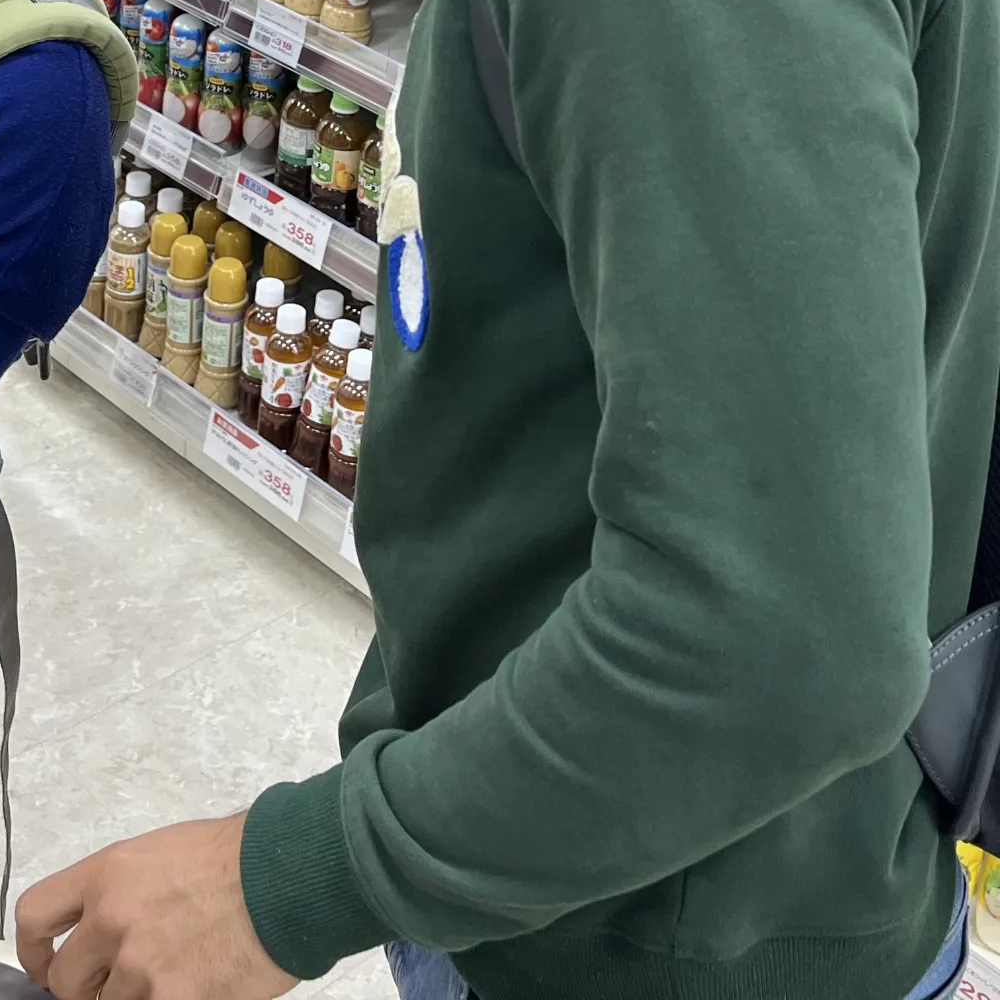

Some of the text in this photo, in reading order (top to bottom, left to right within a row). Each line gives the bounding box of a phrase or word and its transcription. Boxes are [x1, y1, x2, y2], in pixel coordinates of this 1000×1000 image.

[275, 38, 293, 50] 318
[287, 222, 314, 246] 358
[264, 469, 292, 496] 358
